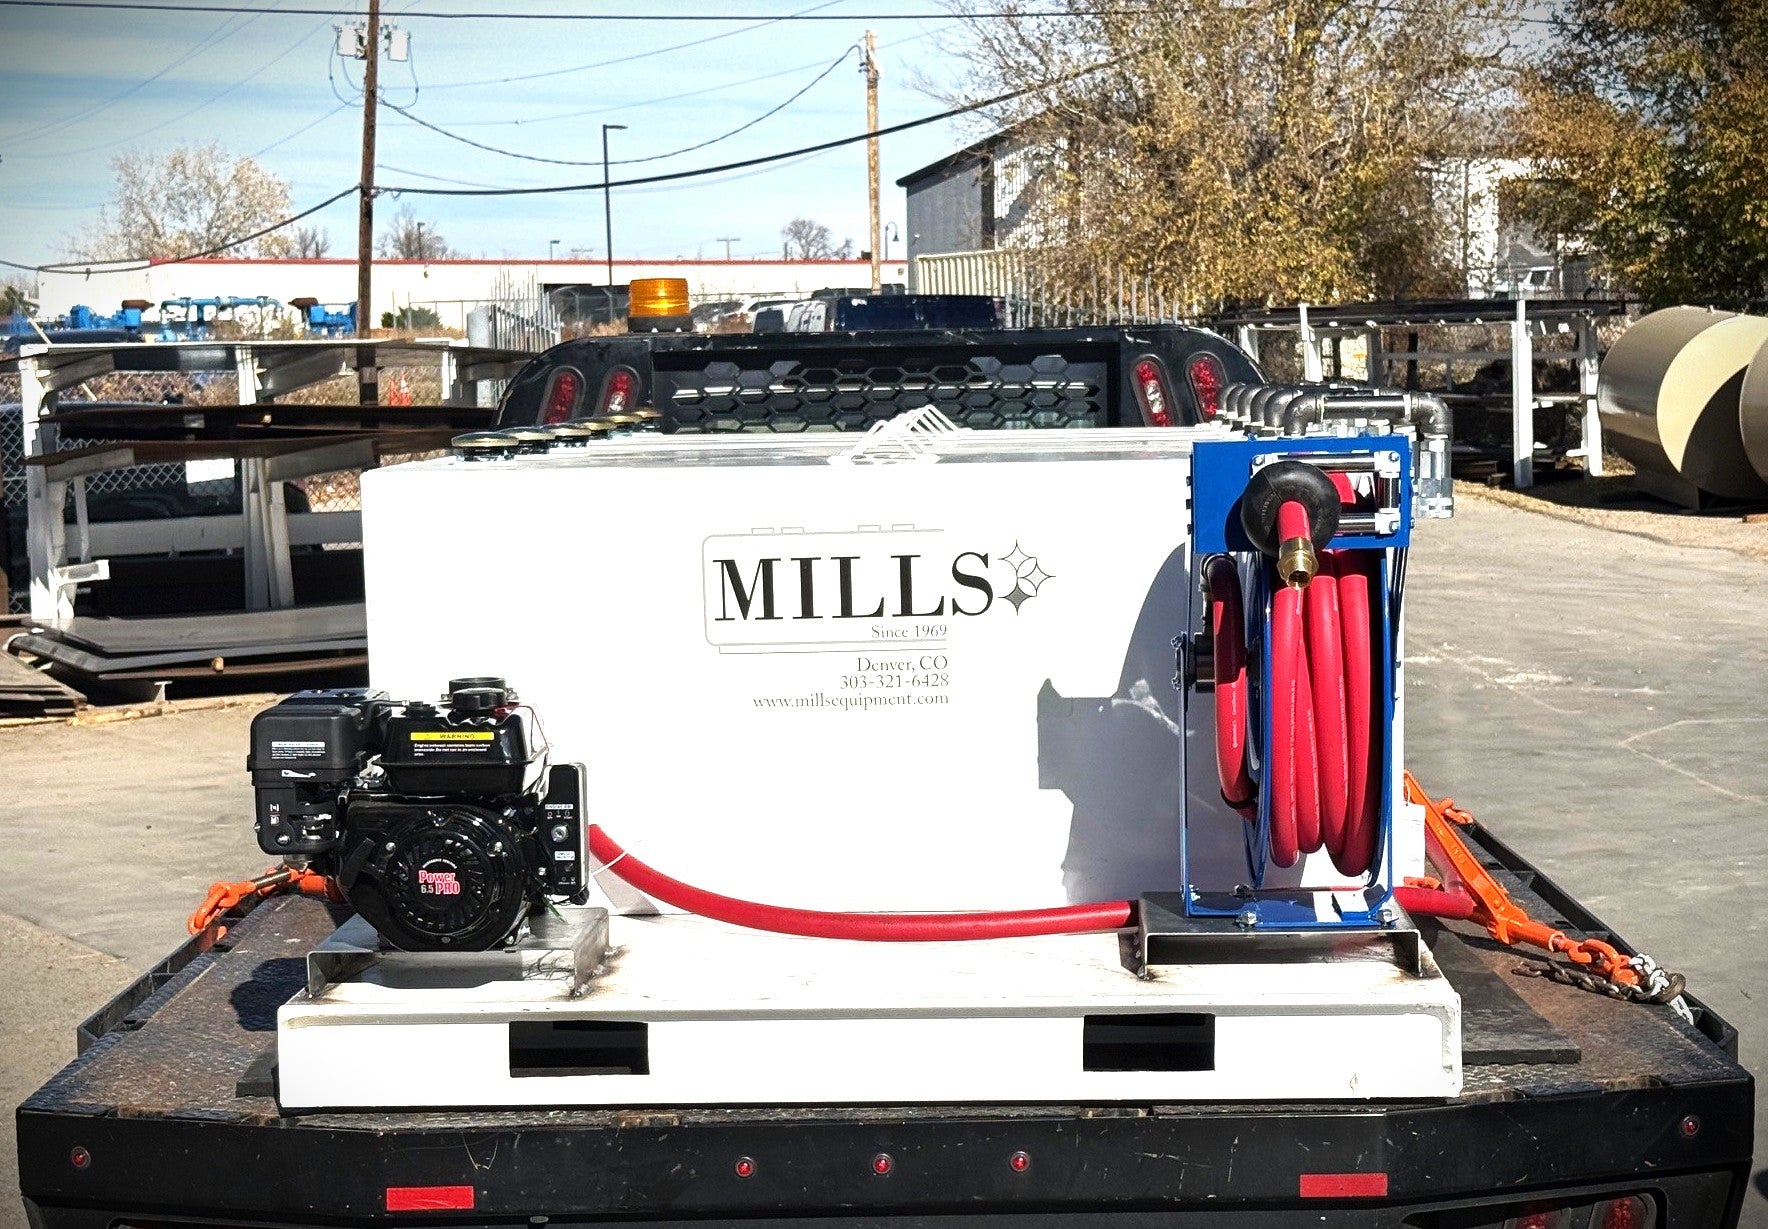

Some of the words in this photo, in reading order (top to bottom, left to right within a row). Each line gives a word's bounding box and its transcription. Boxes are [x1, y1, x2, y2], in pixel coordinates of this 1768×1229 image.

[713, 552, 993, 620] MILLS
[871, 625, 908, 638] Since
[914, 624, 947, 637] 1969
[857, 657, 915, 673] Denver,
[920, 655, 948, 670] CO
[840, 674, 949, 689] 303-321-6428
[753, 693, 949, 711] www.millsequipment.com
[419, 870, 455, 883] Power
[420, 884, 434, 893] 6.5
[435, 881, 460, 894] PRO
